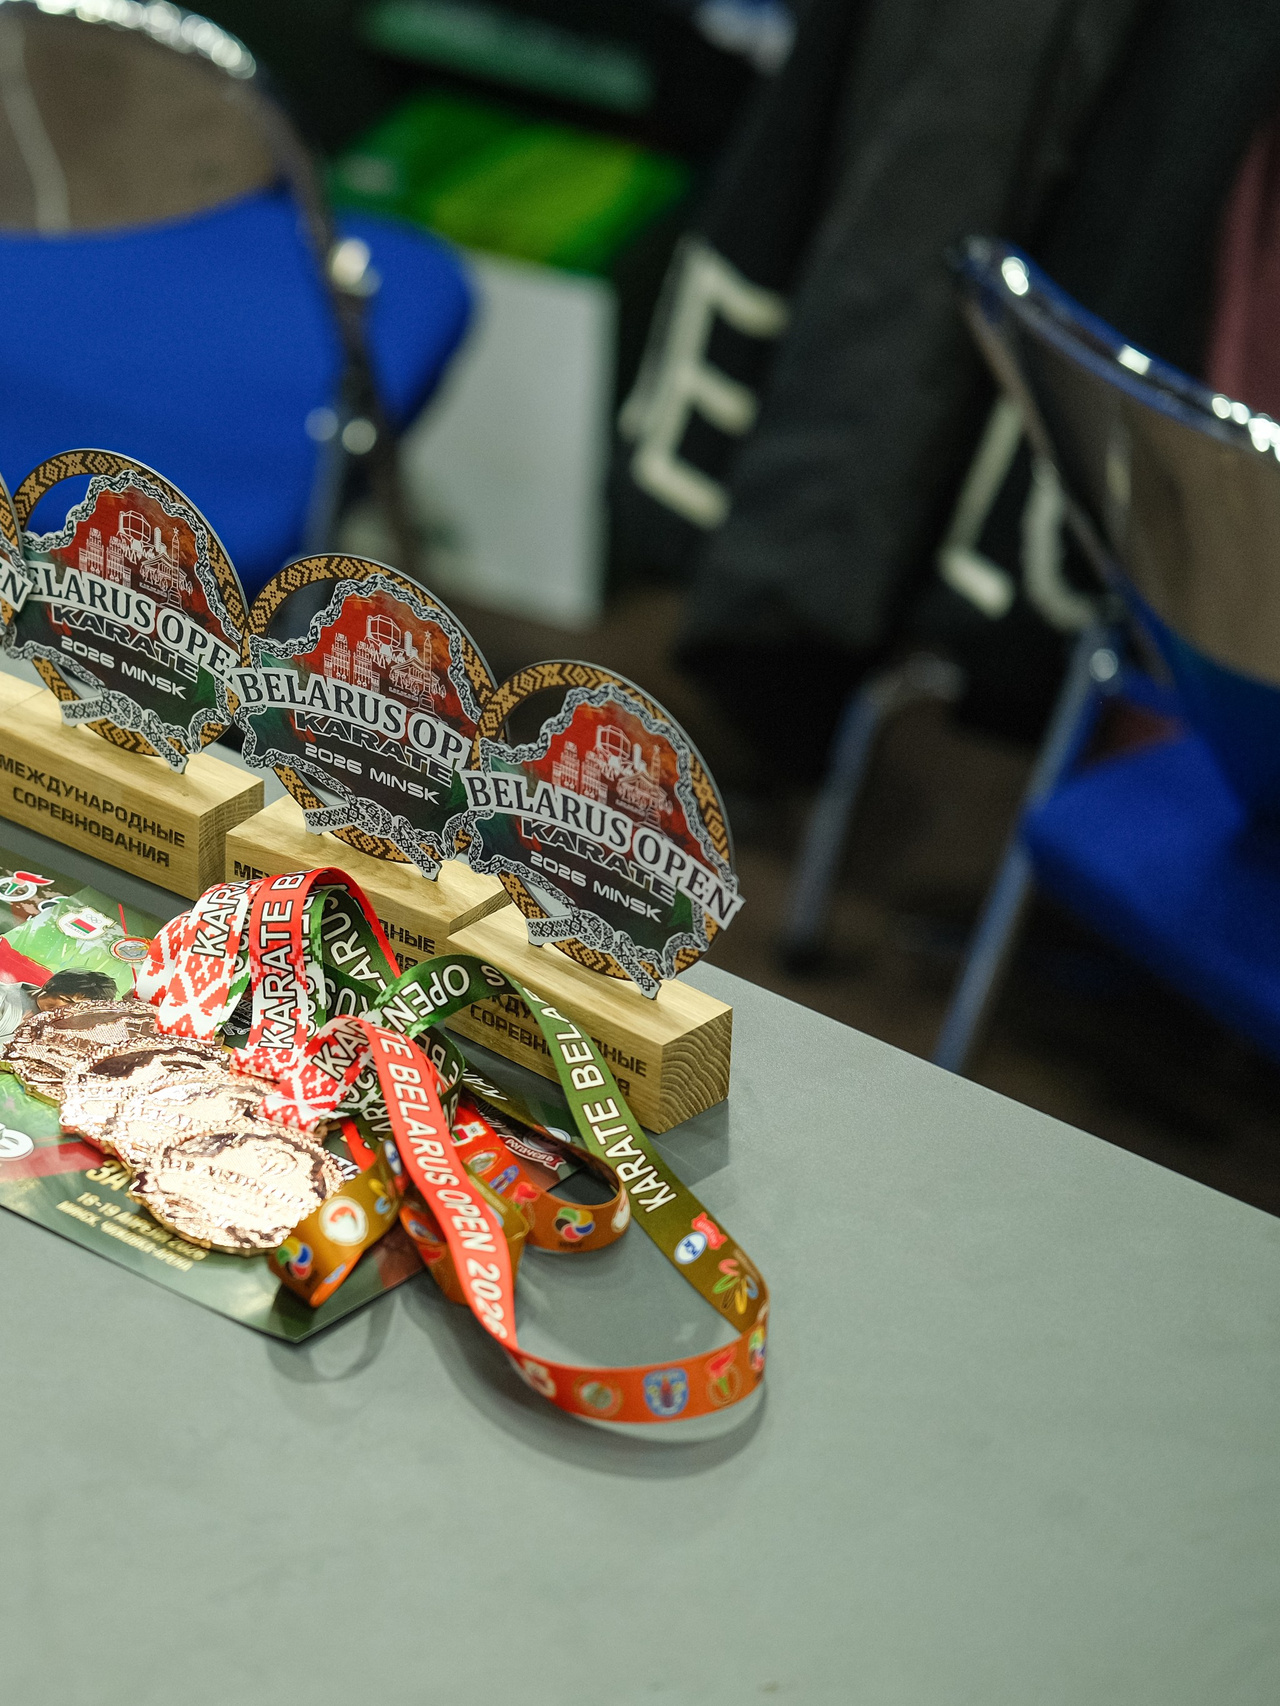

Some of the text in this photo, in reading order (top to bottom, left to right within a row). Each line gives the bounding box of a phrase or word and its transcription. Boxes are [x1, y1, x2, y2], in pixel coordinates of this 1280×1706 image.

[31, 565, 242, 684] ELARUS OPE
[52, 605, 200, 683] KARATE
[61, 635, 187, 700] 2026 MINSK
[237, 672, 473, 770] BELARUS OP
[293, 710, 454, 789] KARATE
[305, 742, 440, 806] 2026 MINSK
[13, 787, 170, 868] СОРЕВНОВАНИЯ
[465, 775, 741, 926] BELARUS OPEN
[522, 819, 678, 906] KARATE
[529, 852, 663, 923] 2026 MINSK
[258, 900, 297, 1050] KARATE
[380, 964, 470, 1034] OPEN
[387, 1062, 461, 1188] BELARUS
[581, 1097, 678, 1213] KARATE
[436, 1188, 498, 1253] OPEN
[466, 1257, 508, 1340] 2026
